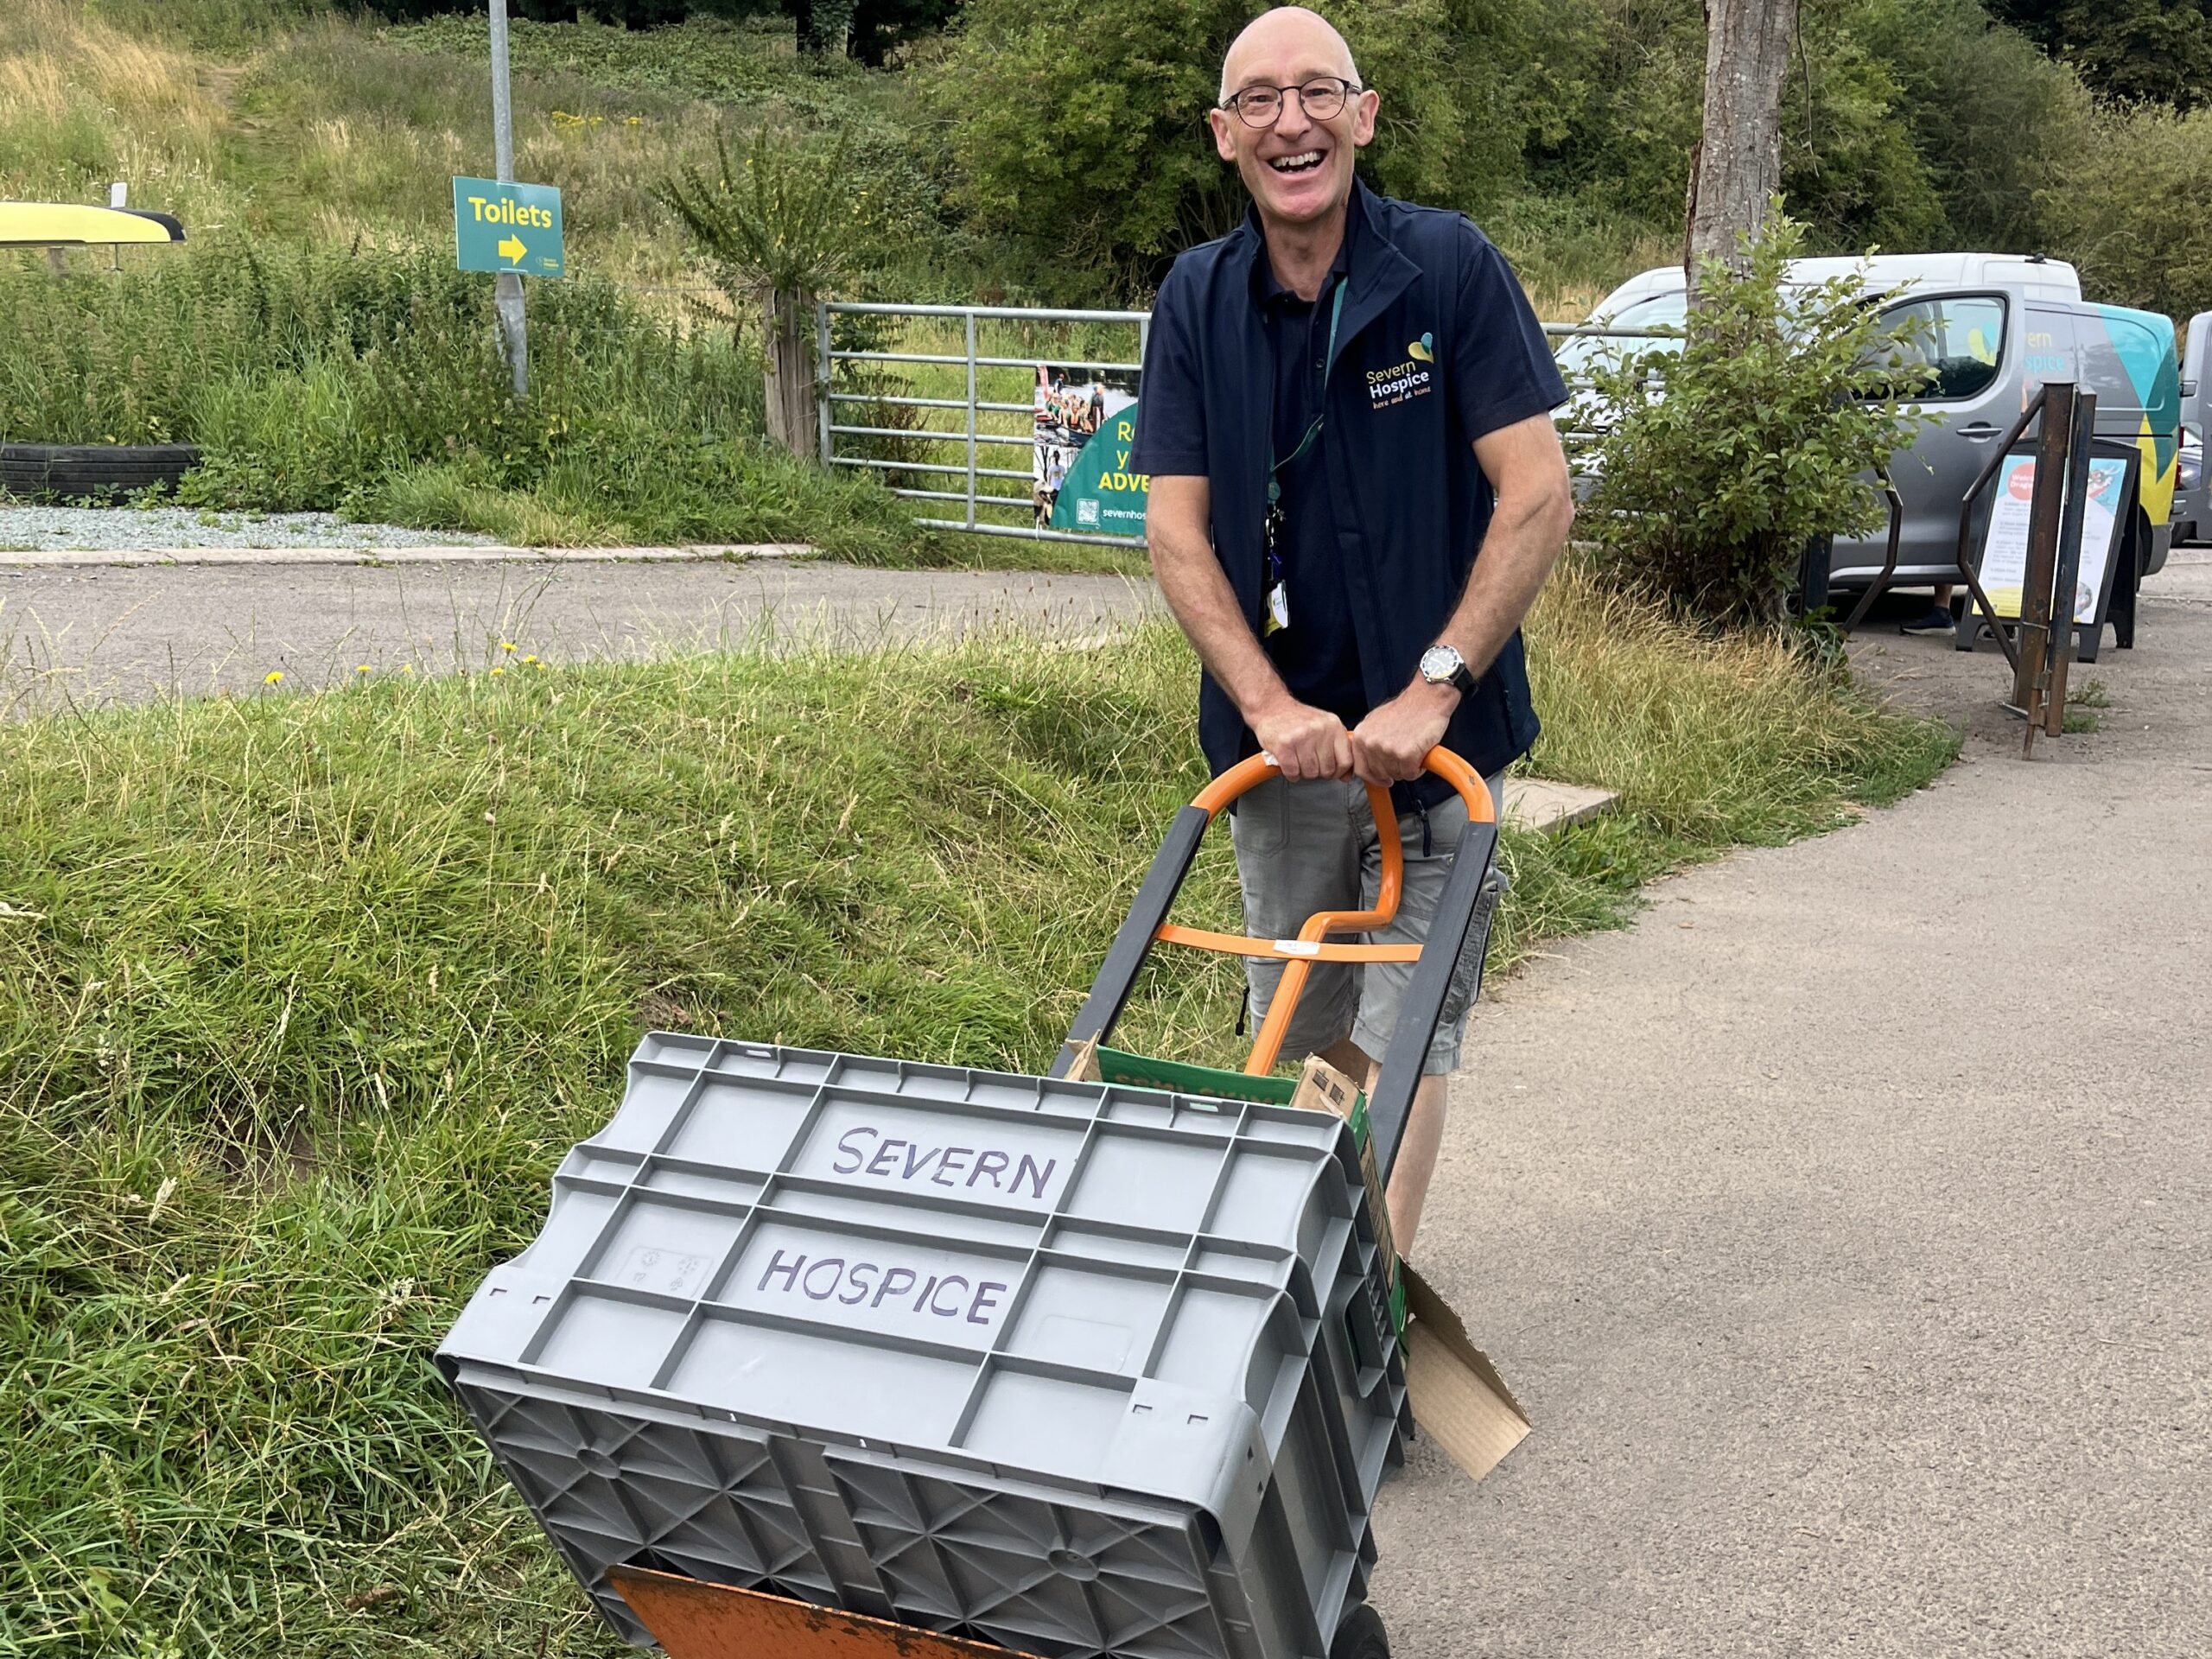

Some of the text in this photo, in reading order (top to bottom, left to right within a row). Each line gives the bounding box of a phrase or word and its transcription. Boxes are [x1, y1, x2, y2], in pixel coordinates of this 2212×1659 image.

[467, 196, 552, 228] Toilets
[2026, 332, 2052, 347] ern
[1366, 360, 1415, 385] Severn
[2024, 354, 2065, 373] spice
[1369, 372, 1429, 398] Hospice
[1372, 385, 1431, 410] here and at home
[1117, 421, 1135, 442] R
[1116, 449, 1129, 470] y
[1098, 472, 1149, 493] ADVE
[1103, 509, 1147, 520] severnhos
[832, 1127, 1057, 1198] SEVERN
[756, 1249, 1007, 1325] HOSPICE
